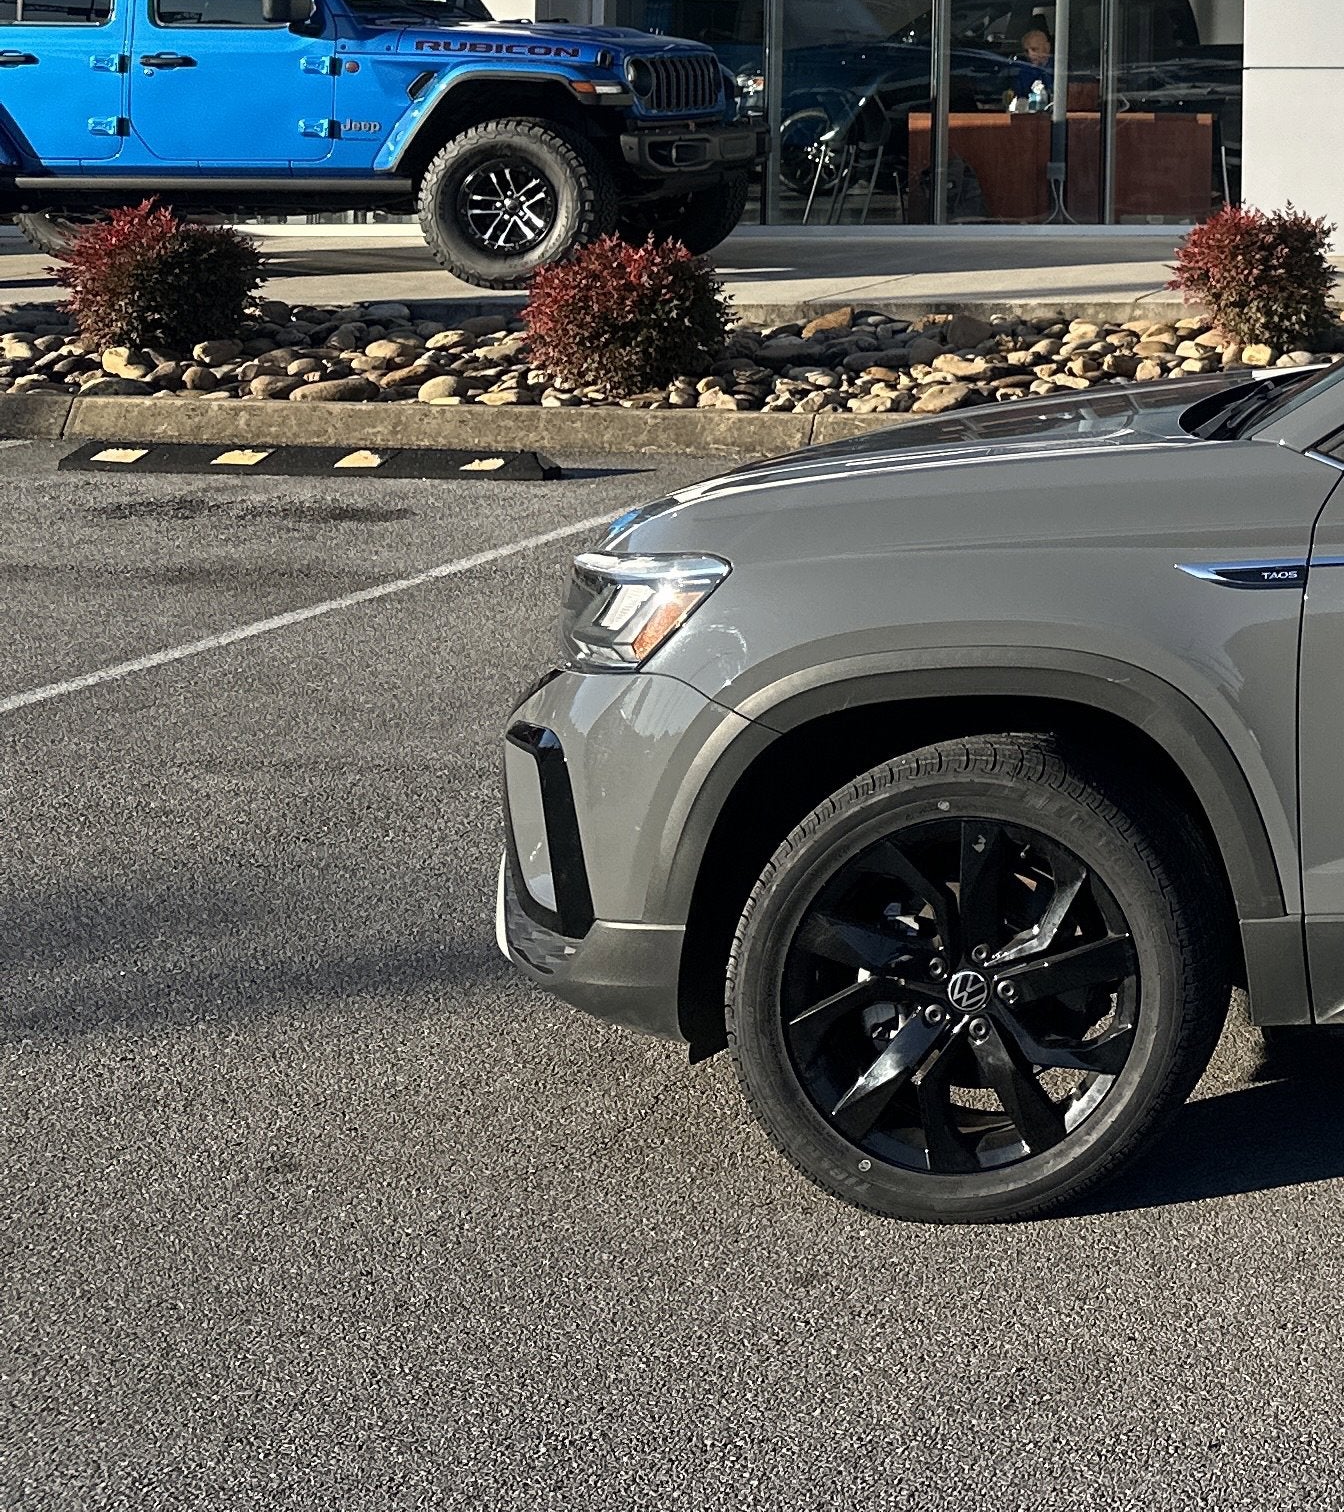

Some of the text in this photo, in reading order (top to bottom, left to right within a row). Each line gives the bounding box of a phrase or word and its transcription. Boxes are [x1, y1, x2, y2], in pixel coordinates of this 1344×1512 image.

[414, 39, 581, 58] RUBICON
[340, 118, 380, 134] Jeep
[1261, 570, 1298, 580] TAOS
